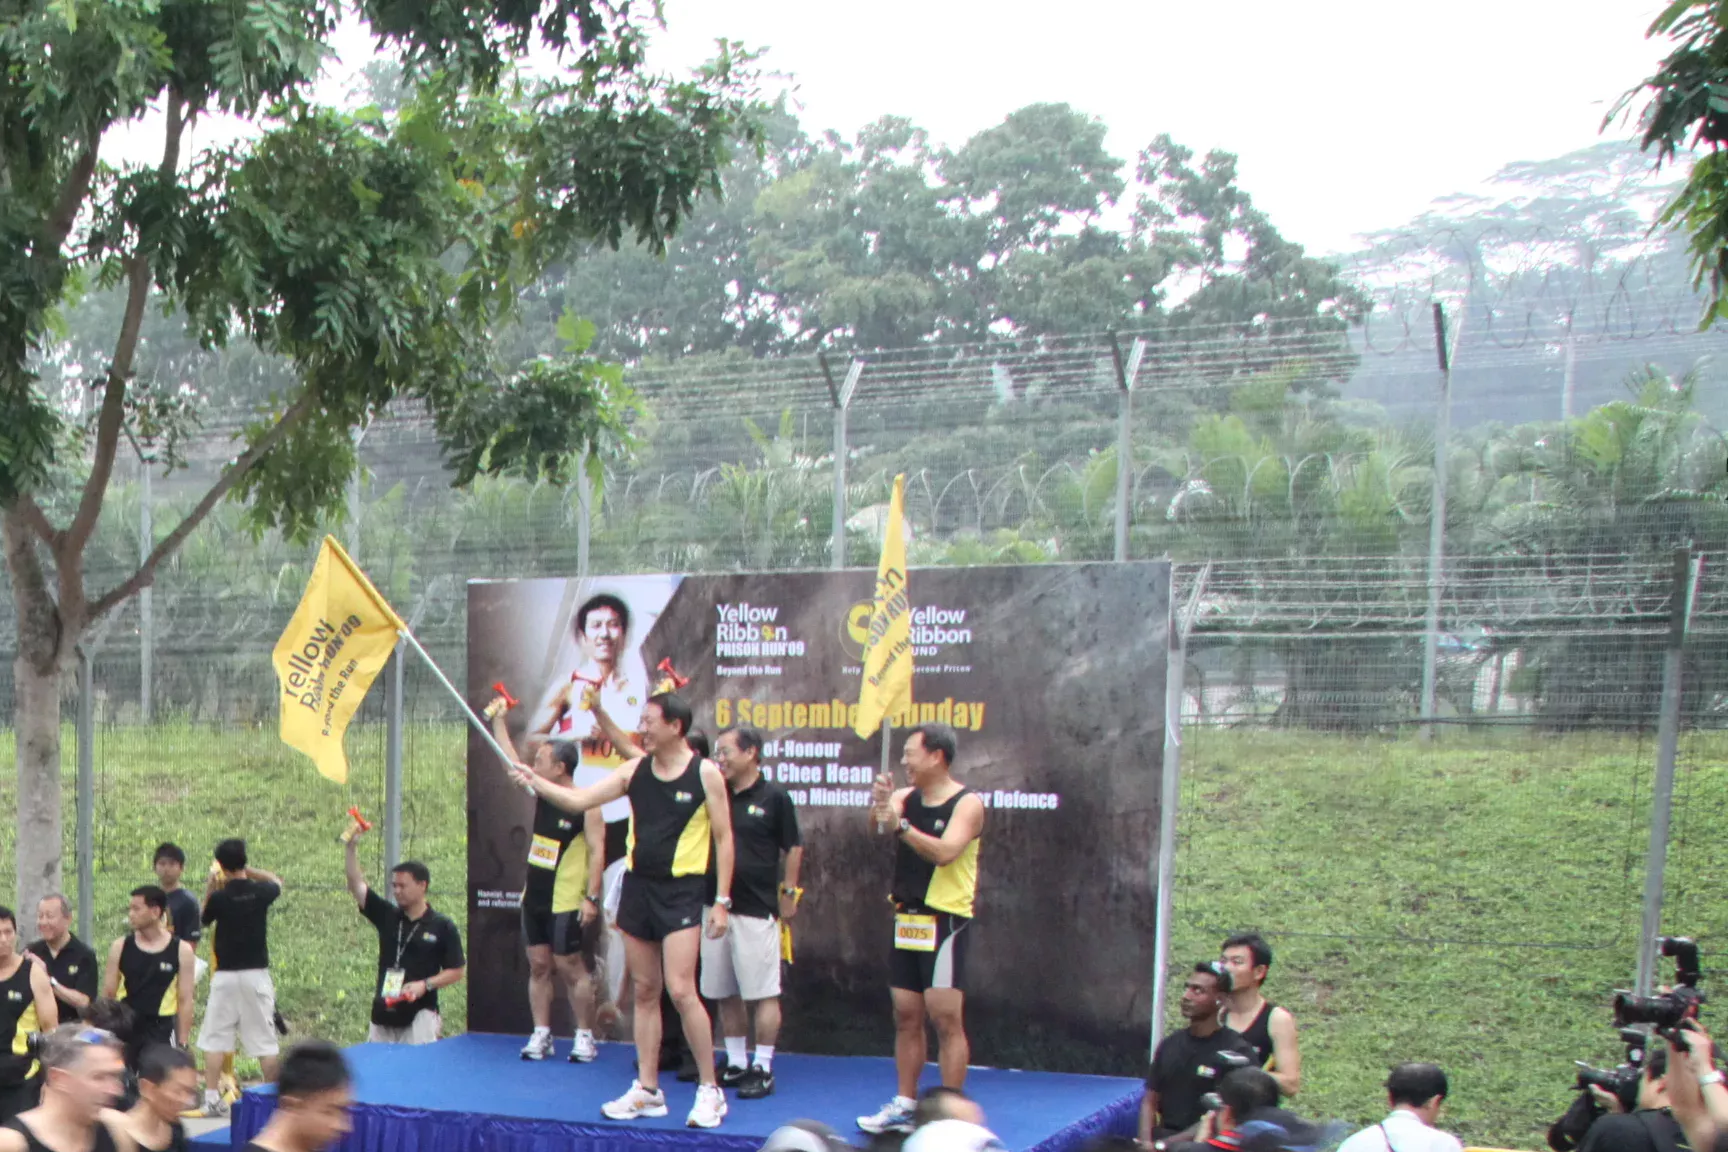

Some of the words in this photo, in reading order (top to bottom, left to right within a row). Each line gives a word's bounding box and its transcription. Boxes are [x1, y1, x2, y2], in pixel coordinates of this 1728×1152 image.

[716, 602, 778, 622] Yellow
[716, 641, 760, 657] PRISON
[911, 645, 938, 656] UND
[329, 678, 346, 700] the
[339, 658, 359, 680] Run
[716, 665, 747, 677] Beyond
[748, 665, 763, 676] the
[764, 664, 782, 675] Run
[841, 665, 861, 675] Help
[715, 699, 733, 728] 6
[737, 698, 862, 731] Septembe
[776, 762, 822, 784] Chee
[826, 762, 873, 784] Hean
[993, 789, 1059, 810] Defence
[899, 926, 928, 940] 0075
